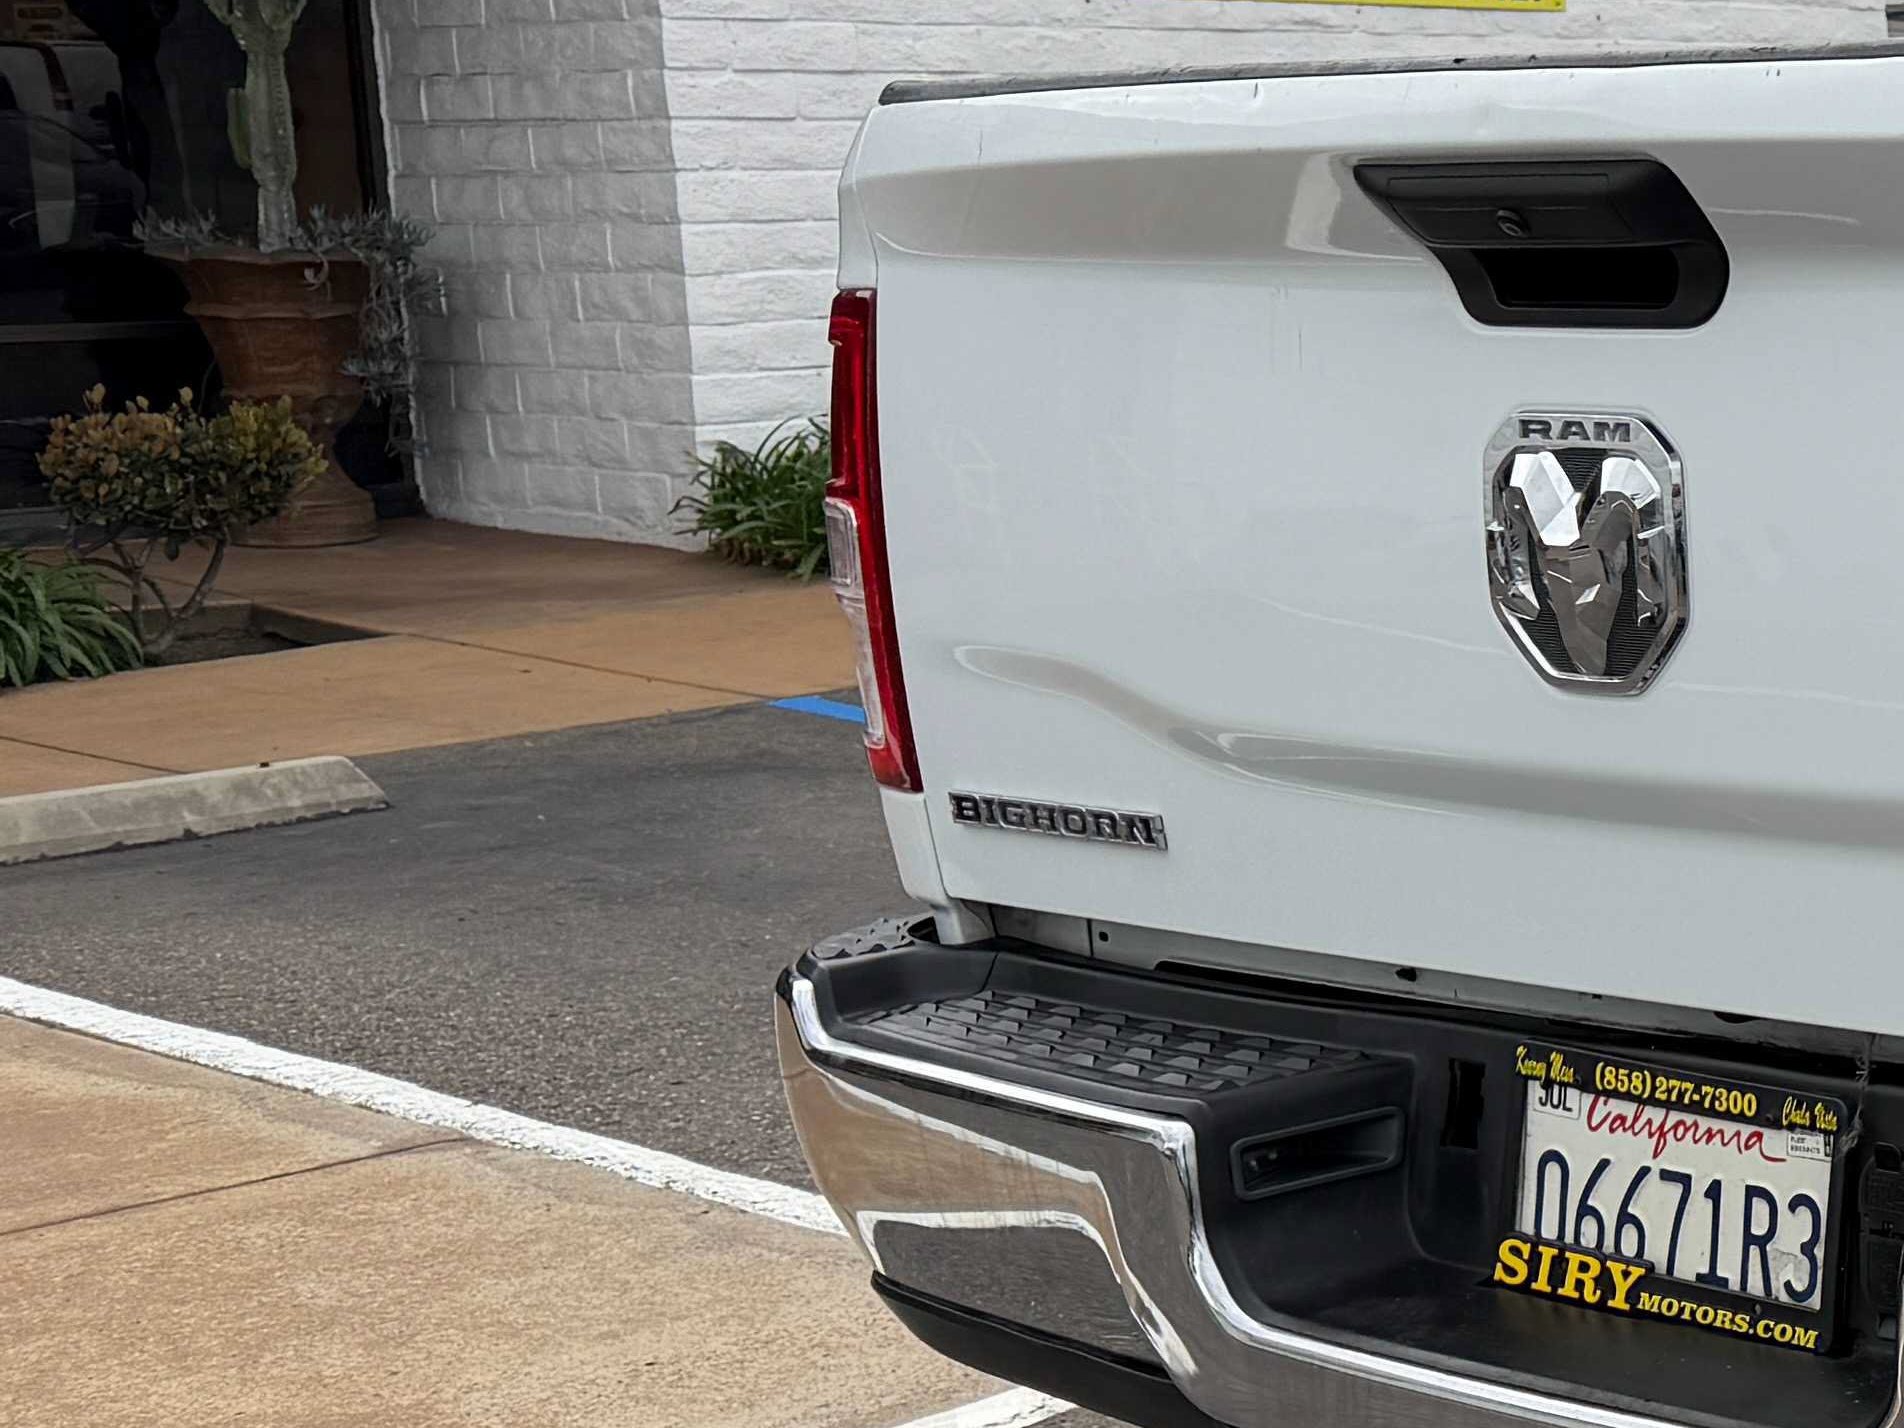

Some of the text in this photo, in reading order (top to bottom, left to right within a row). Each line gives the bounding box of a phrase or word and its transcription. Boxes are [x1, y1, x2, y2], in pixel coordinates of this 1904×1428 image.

[1518, 419, 1631, 443] RAM
[948, 789, 1167, 850] BIGHORN
[1595, 1061, 1651, 1098] (858)
[1655, 1076, 1758, 1117] 277-7300
[1586, 1093, 1787, 1162] California
[1534, 1148, 1823, 1304] 06671R3
[1493, 1238, 1819, 1349] SIRY MOTORS.COM
